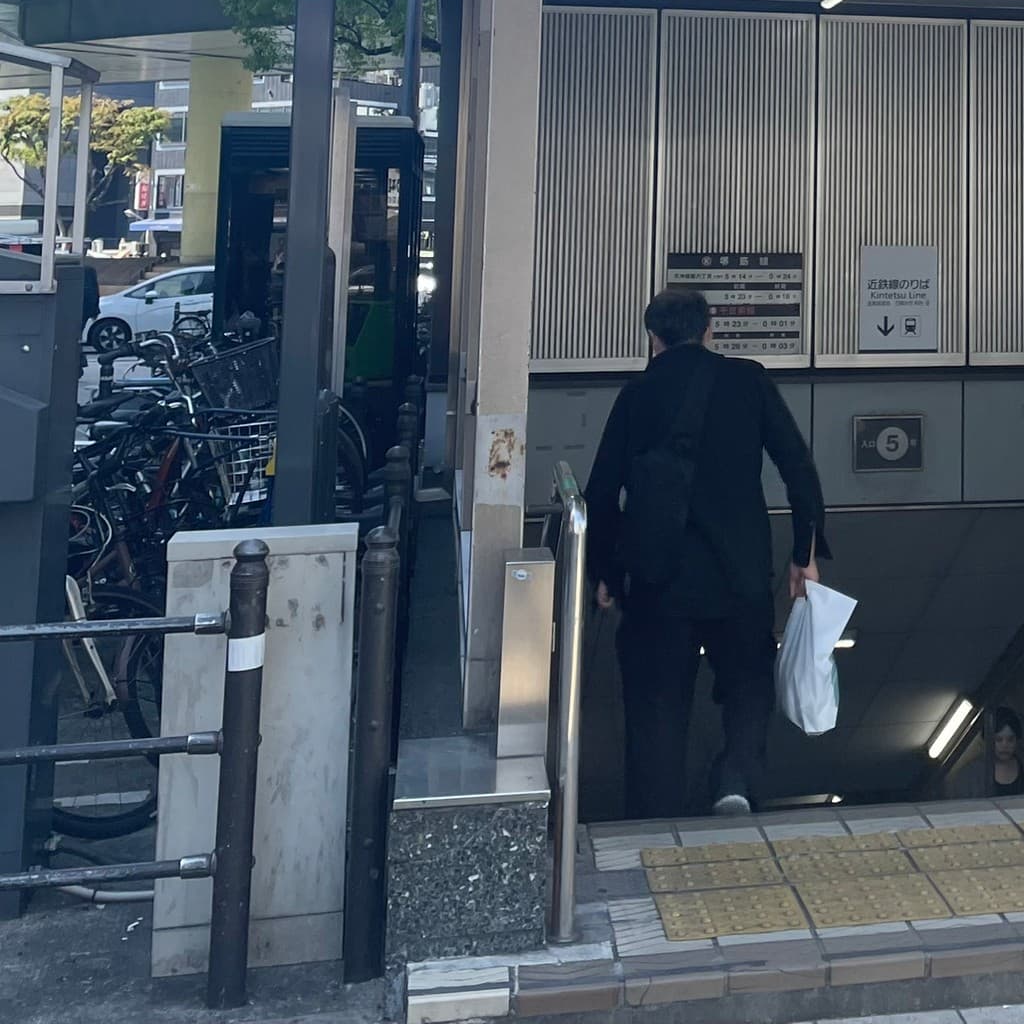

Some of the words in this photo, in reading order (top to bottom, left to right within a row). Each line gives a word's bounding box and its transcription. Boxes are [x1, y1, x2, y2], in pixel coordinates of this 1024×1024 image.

[870, 291, 906, 300] Kintetsu
[908, 291, 927, 300] Line
[885, 434, 899, 453] 5
